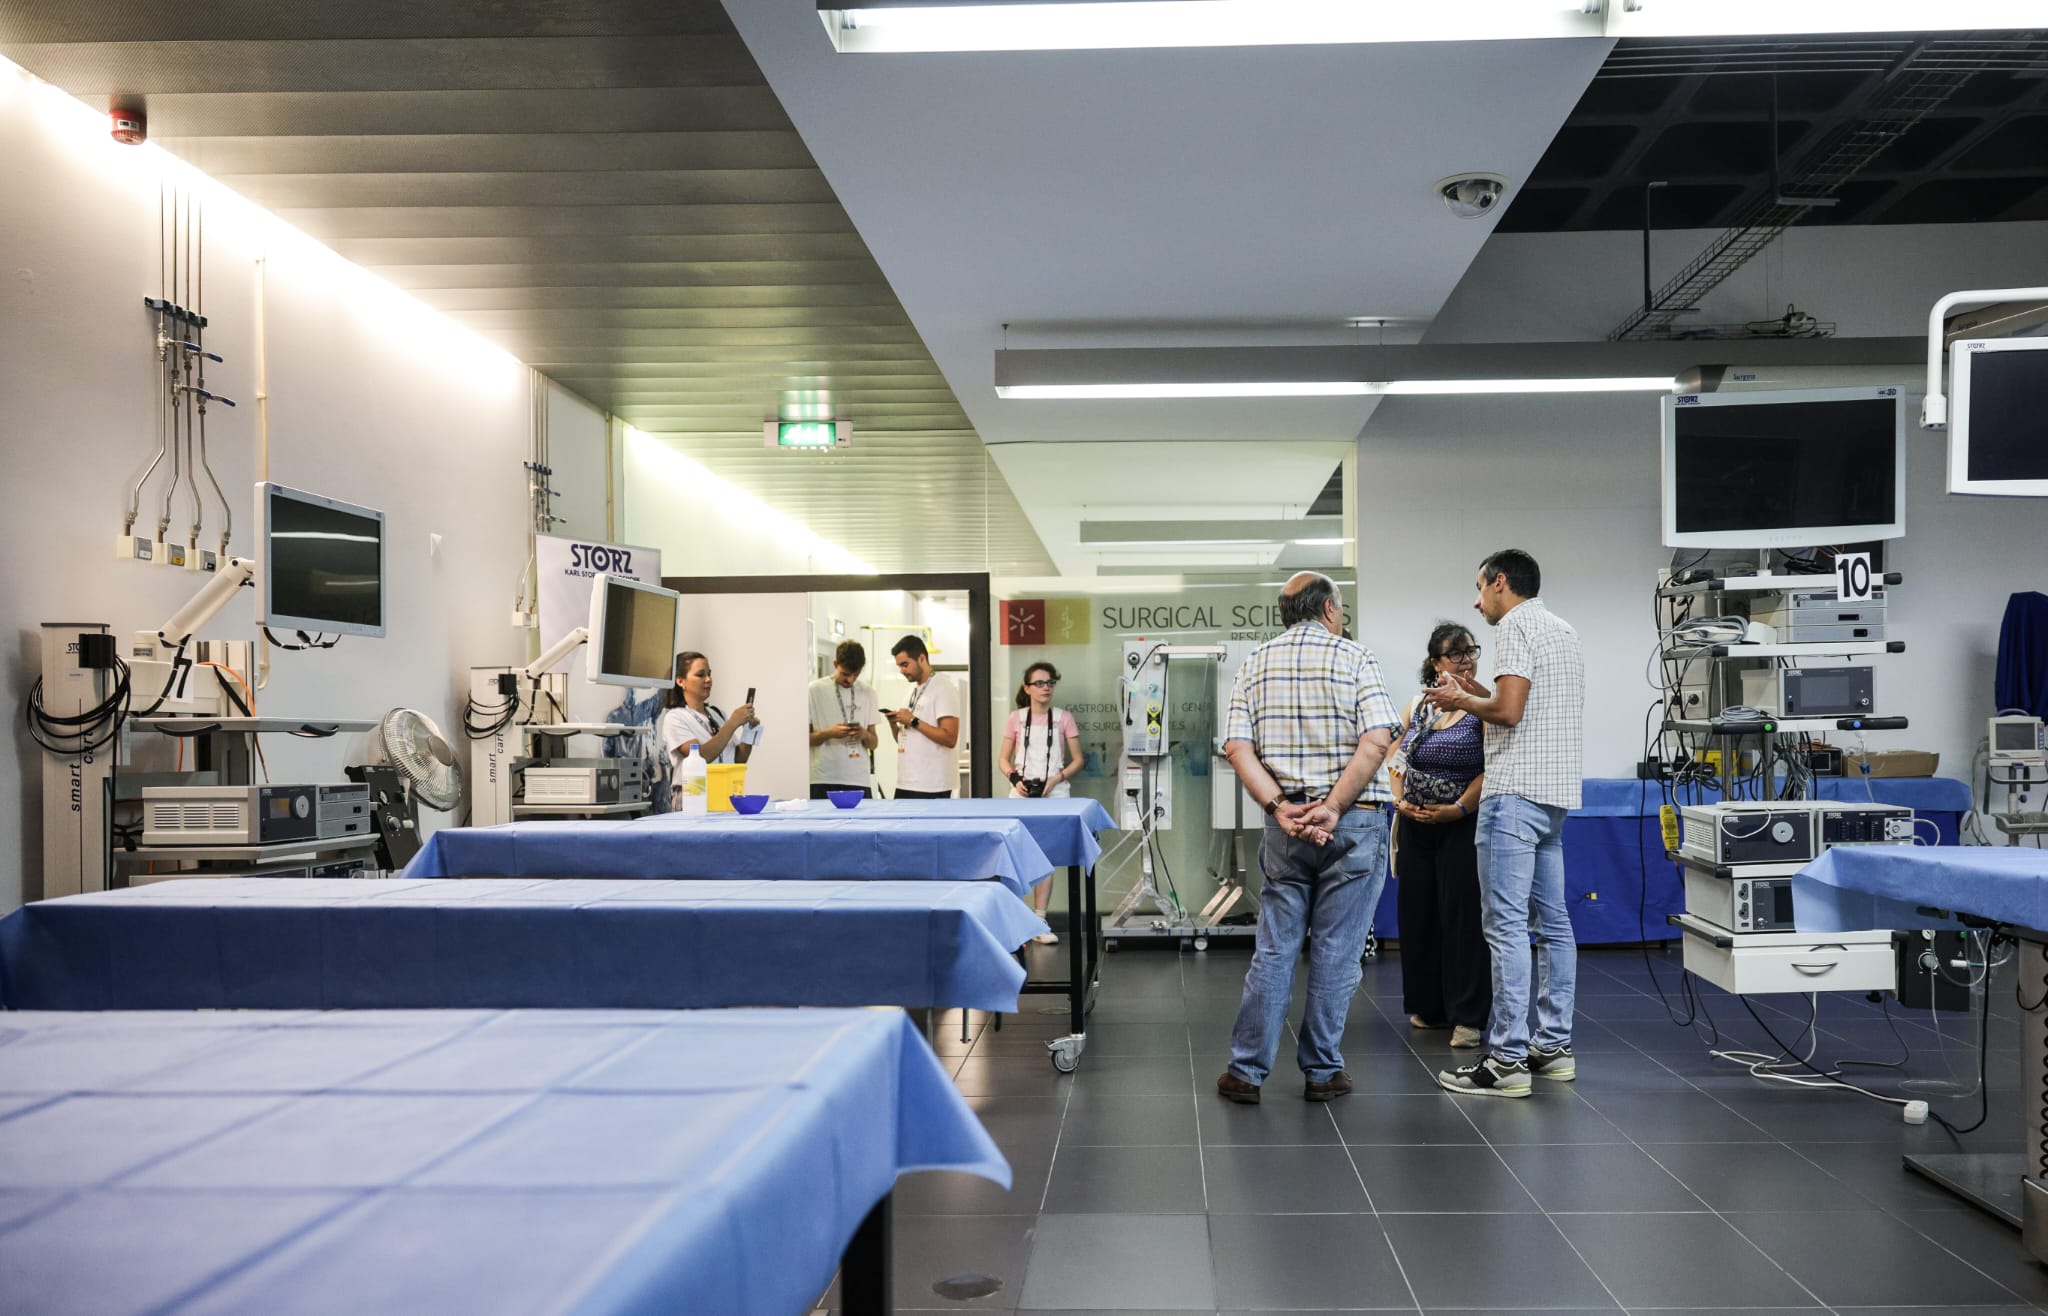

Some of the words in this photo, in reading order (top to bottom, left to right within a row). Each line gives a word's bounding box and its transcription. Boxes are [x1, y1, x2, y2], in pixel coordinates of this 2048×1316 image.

[565, 569, 581, 577] KARL
[571, 544, 633, 574] STORZ
[1838, 556, 1870, 598] 10
[1103, 606, 1222, 629] SURGICAL
[1232, 604, 1351, 627] SCIES
[1065, 703, 1118, 713] GASTROEN
[488, 753, 497, 783] smart
[69, 763, 80, 812] smart
